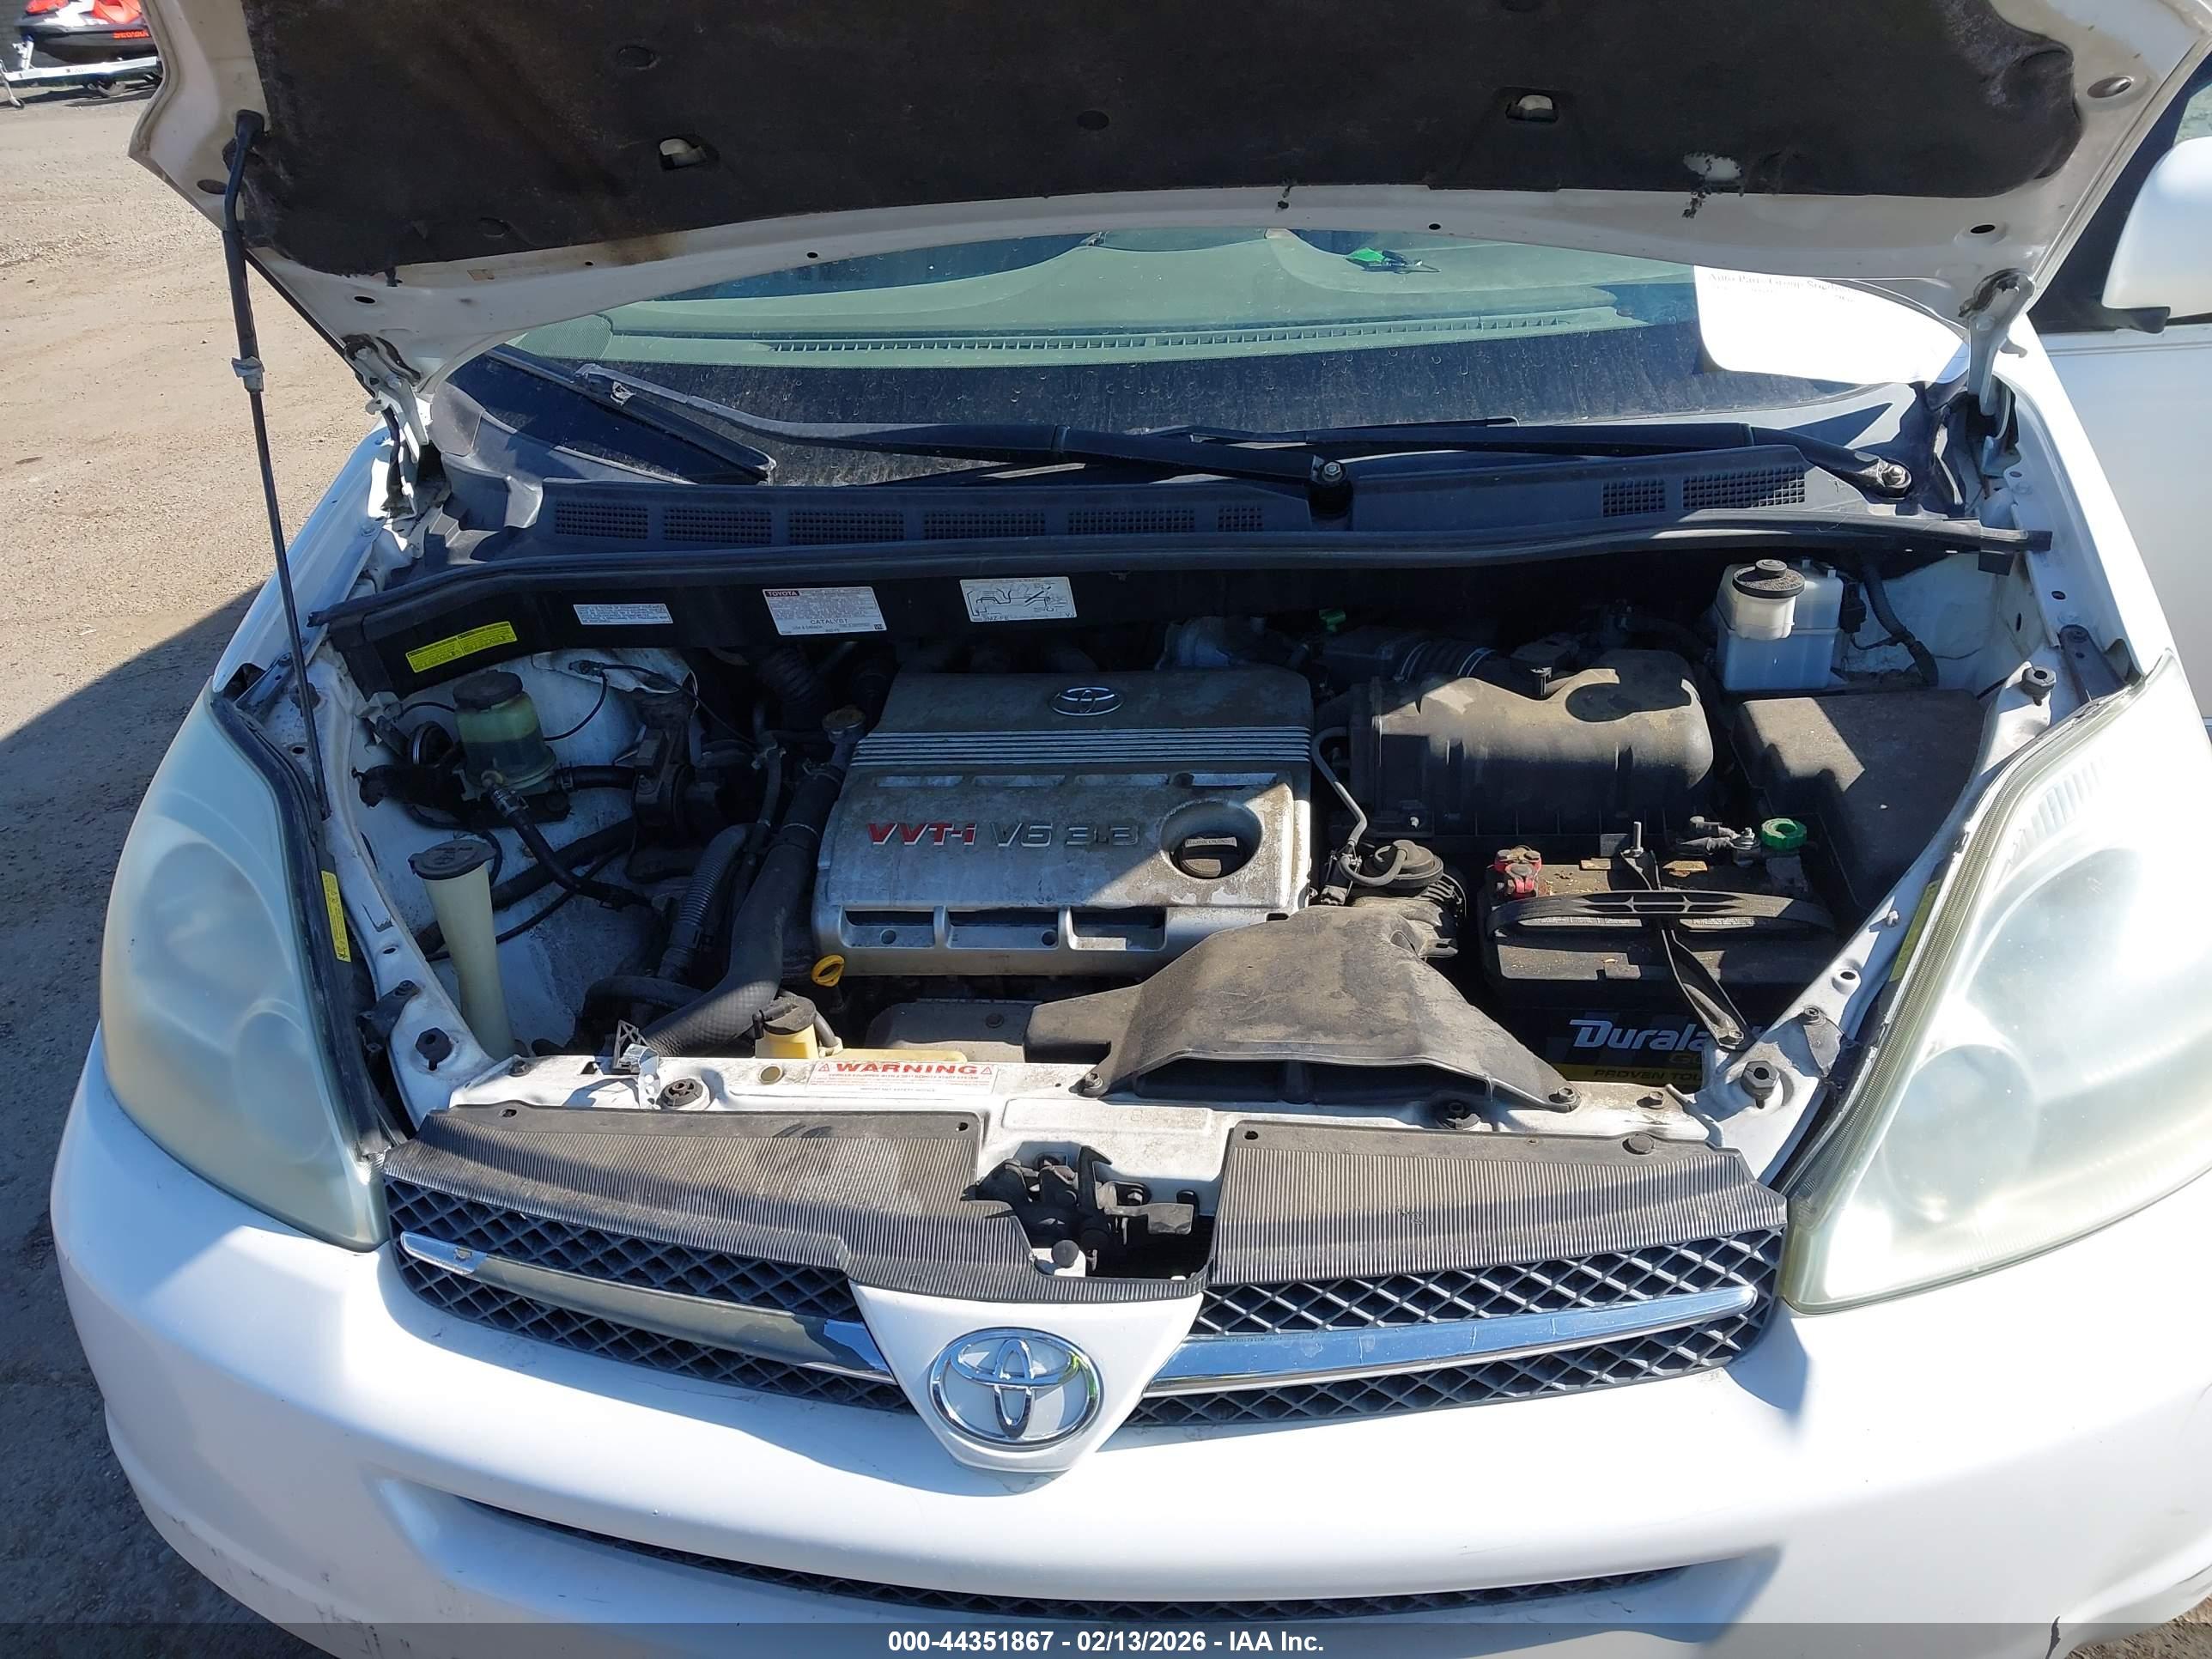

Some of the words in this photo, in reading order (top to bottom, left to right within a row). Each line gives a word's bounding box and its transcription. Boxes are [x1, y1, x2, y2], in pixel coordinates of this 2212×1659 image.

[866, 822, 977, 846] VVT-i
[990, 822, 1053, 848] V6
[1066, 826, 1139, 847] 3.3
[1568, 1018, 1710, 1052] Durala
[836, 1062, 977, 1075] WARNING
[1593, 1069, 1664, 1080] PROVEN
